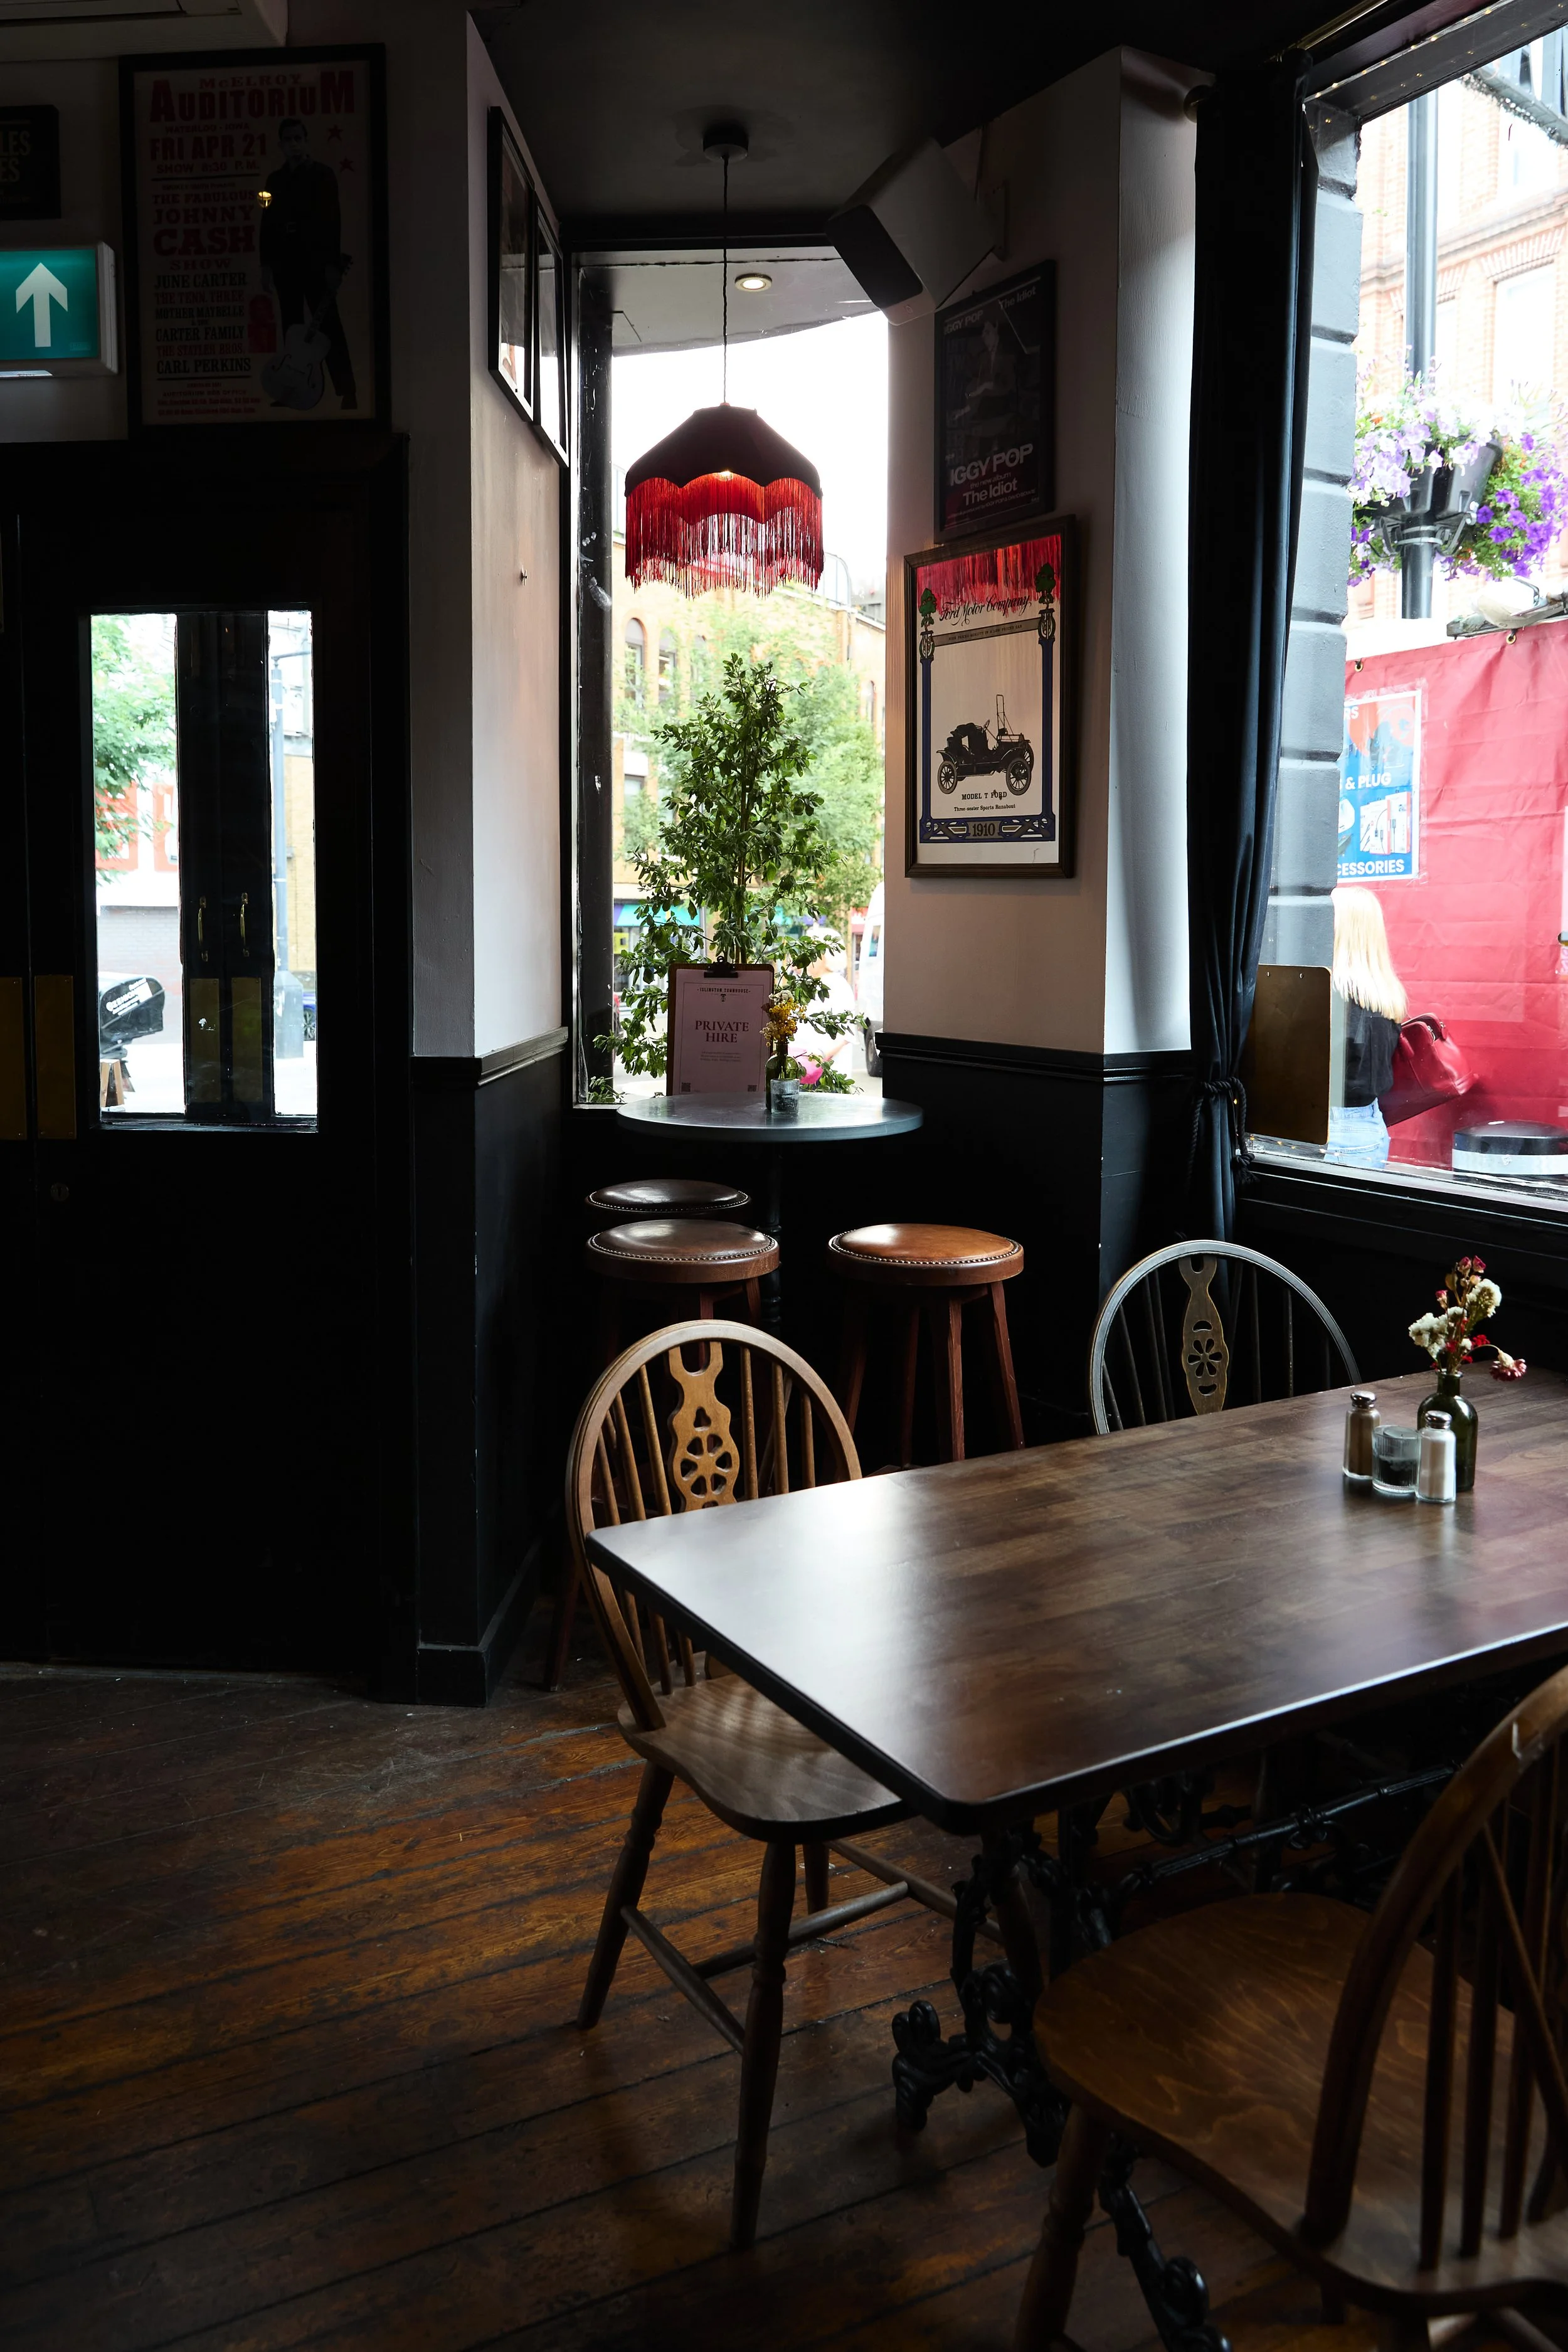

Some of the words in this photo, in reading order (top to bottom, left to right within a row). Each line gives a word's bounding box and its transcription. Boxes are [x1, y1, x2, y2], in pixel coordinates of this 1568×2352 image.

[150, 70, 355, 122] AUDITORIUM
[165, 125, 216, 133] WATERLOO
[225, 122, 250, 130] IOWA
[150, 137, 184, 161] FRI
[192, 135, 234, 159] APR
[242, 133, 266, 156] 21
[156, 163, 194, 174] SHOW
[201, 162, 226, 172] 8:30
[152, 194, 179, 204] THE
[184, 189, 255, 203] FABULOUS
[154, 204, 254, 225] JOHNNY
[154, 225, 255, 257] CASH
[170, 258, 232, 270] SHOW
[154, 275, 189, 290] JUNE
[193, 273, 247, 288] CARTER
[154, 292, 175, 305] THE
[209, 290, 244, 302] THREE
[998, 297, 1015, 310] The
[1017, 285, 1036, 302] Idiot
[156, 307, 194, 319] MOTHER
[196, 305, 244, 318] MAYBELLE
[943, 319, 963, 335] IGGY
[965, 310, 983, 326] POP
[156, 327, 201, 341] CARTER
[204, 326, 245, 340] FAMILY
[157, 346, 174, 357] THE
[177, 344, 215, 356] STATLER
[157, 360, 189, 374] CARL
[194, 358, 251, 373] PERKINS
[951, 456, 990, 487] IGGY
[993, 443, 1033, 472] POP
[980, 478, 992, 486] new
[992, 472, 1011, 482] album
[963, 490, 987, 506] The
[989, 477, 1017, 498] Idiot
[940, 601, 961, 621] Ford
[951, 603, 985, 626] Motor
[987, 593, 1032, 616] Company
[1345, 776, 1355, 790] &
[1359, 772, 1392, 788] PLUG
[991, 791, 1007, 799] FORD
[972, 823, 995, 836] 1910
[695, 1020, 749, 1032] PRIVATE
[706, 1033, 737, 1042] HIRE
